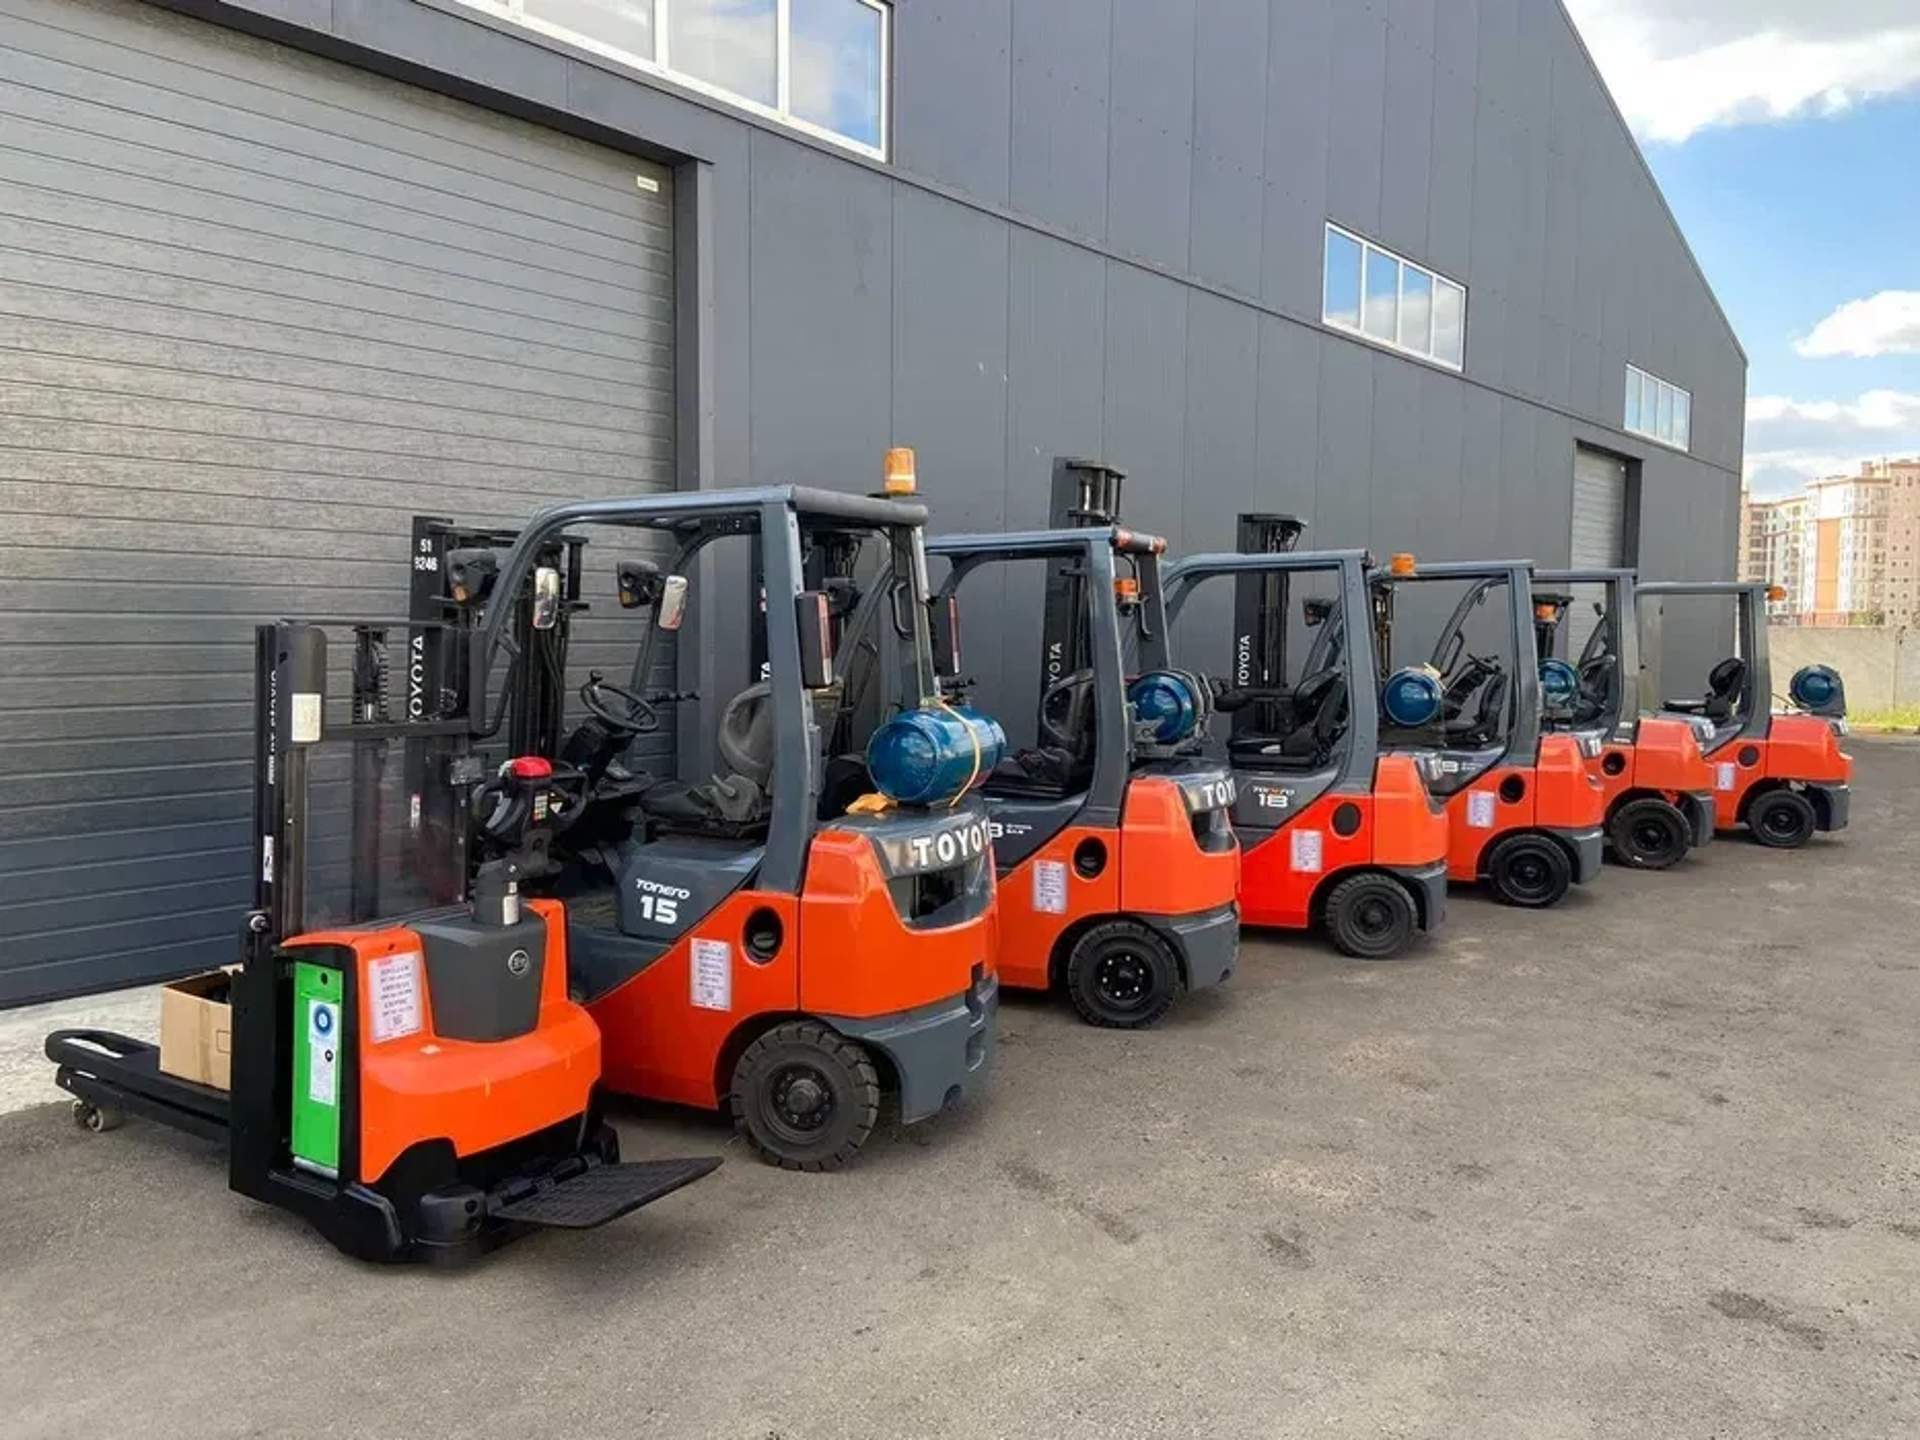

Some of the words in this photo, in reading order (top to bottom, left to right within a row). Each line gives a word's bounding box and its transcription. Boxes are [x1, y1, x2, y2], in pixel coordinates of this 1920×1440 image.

[1048, 642, 1062, 688] YOTA
[1238, 634, 1250, 686] TOYOTA
[1202, 777, 1237, 808] TOY
[912, 817, 990, 866] TOYOT
[640, 895, 677, 924] 15
